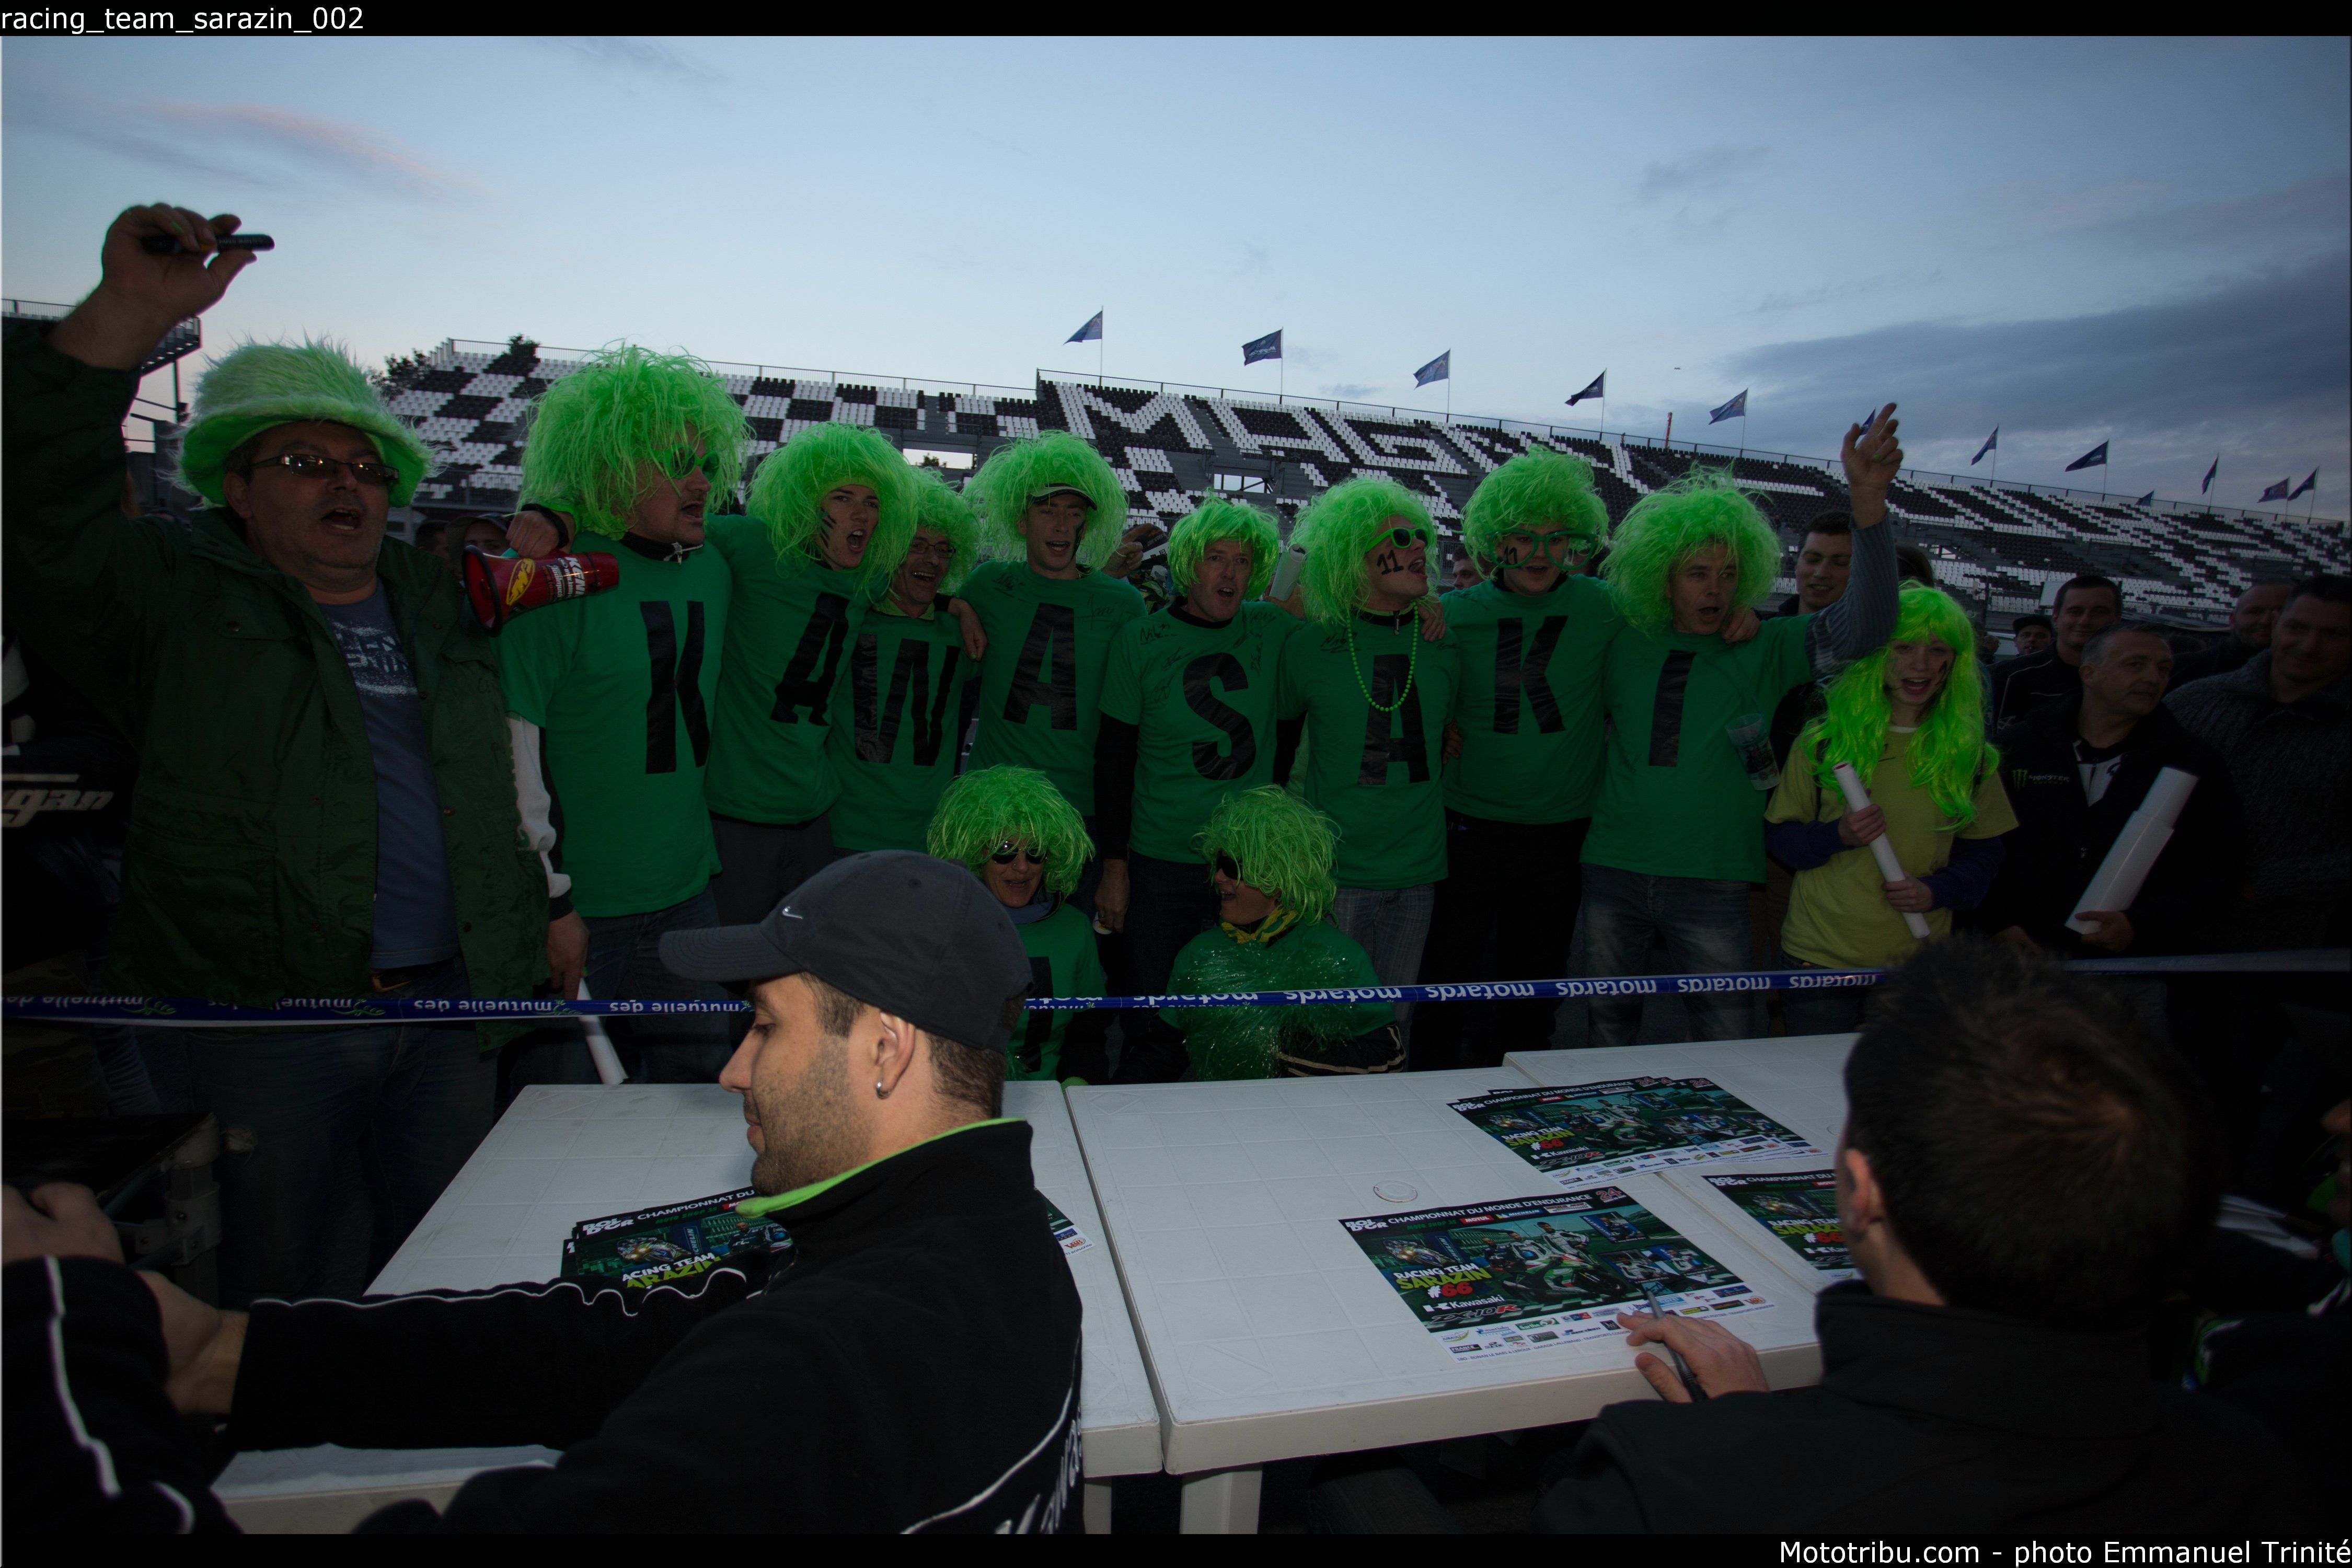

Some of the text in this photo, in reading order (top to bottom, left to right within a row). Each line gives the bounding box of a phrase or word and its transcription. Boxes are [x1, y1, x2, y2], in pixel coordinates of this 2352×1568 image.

[1377, 549, 1404, 575] 11
[769, 592, 850, 726] A
[1002, 602, 1077, 730] A
[1493, 615, 1568, 734] K
[639, 601, 710, 775] K
[851, 633, 960, 766] W
[1182, 652, 1256, 780] S
[1358, 654, 1430, 785] A
[2028, 774, 2070, 782] MONSTER
[3, 789, 114, 828] gan
[1427, 983, 1535, 998] motards
[1557, 978, 1657, 996] motards
[1677, 976, 1771, 993] motards
[1789, 974, 1875, 989] motards
[1286, 987, 1402, 1005] motards
[414, 999, 552, 1012] mutuelle des
[609, 1000, 740, 1014] mutuelle des
[1484, 1092, 1541, 1104] CHAMPIONNAT
[1554, 1086, 1581, 1094] MONDE
[1582, 1080, 1634, 1091] D'ENDURANCE
[1501, 1126, 1564, 1141] RACING TEAM
[1505, 1129, 1576, 1146] SARAZIN
[1530, 1138, 1564, 1150] #66
[1551, 1146, 1590, 1157] Kawasaki
[637, 1189, 756, 1220] CHAMPIONNAT DU
[1388, 1209, 1466, 1224] CHAMPIONNAT
[1483, 1201, 1524, 1212] MONDE
[1523, 1194, 1593, 1207] D'ENDURANCE
[1596, 1187, 1622, 1201] 24
[1509, 1208, 1540, 1217] MICHELIN
[655, 1215, 679, 1225] MOTO
[682, 1210, 705, 1219] SHOP
[622, 1252, 716, 1282] ACING TEAM
[1393, 1262, 1480, 1279] RACING TEAM
[1396, 1267, 1493, 1289] SARAZIN
[1427, 1282, 1473, 1299] #66
[1450, 1294, 1505, 1309] Kawasaki
